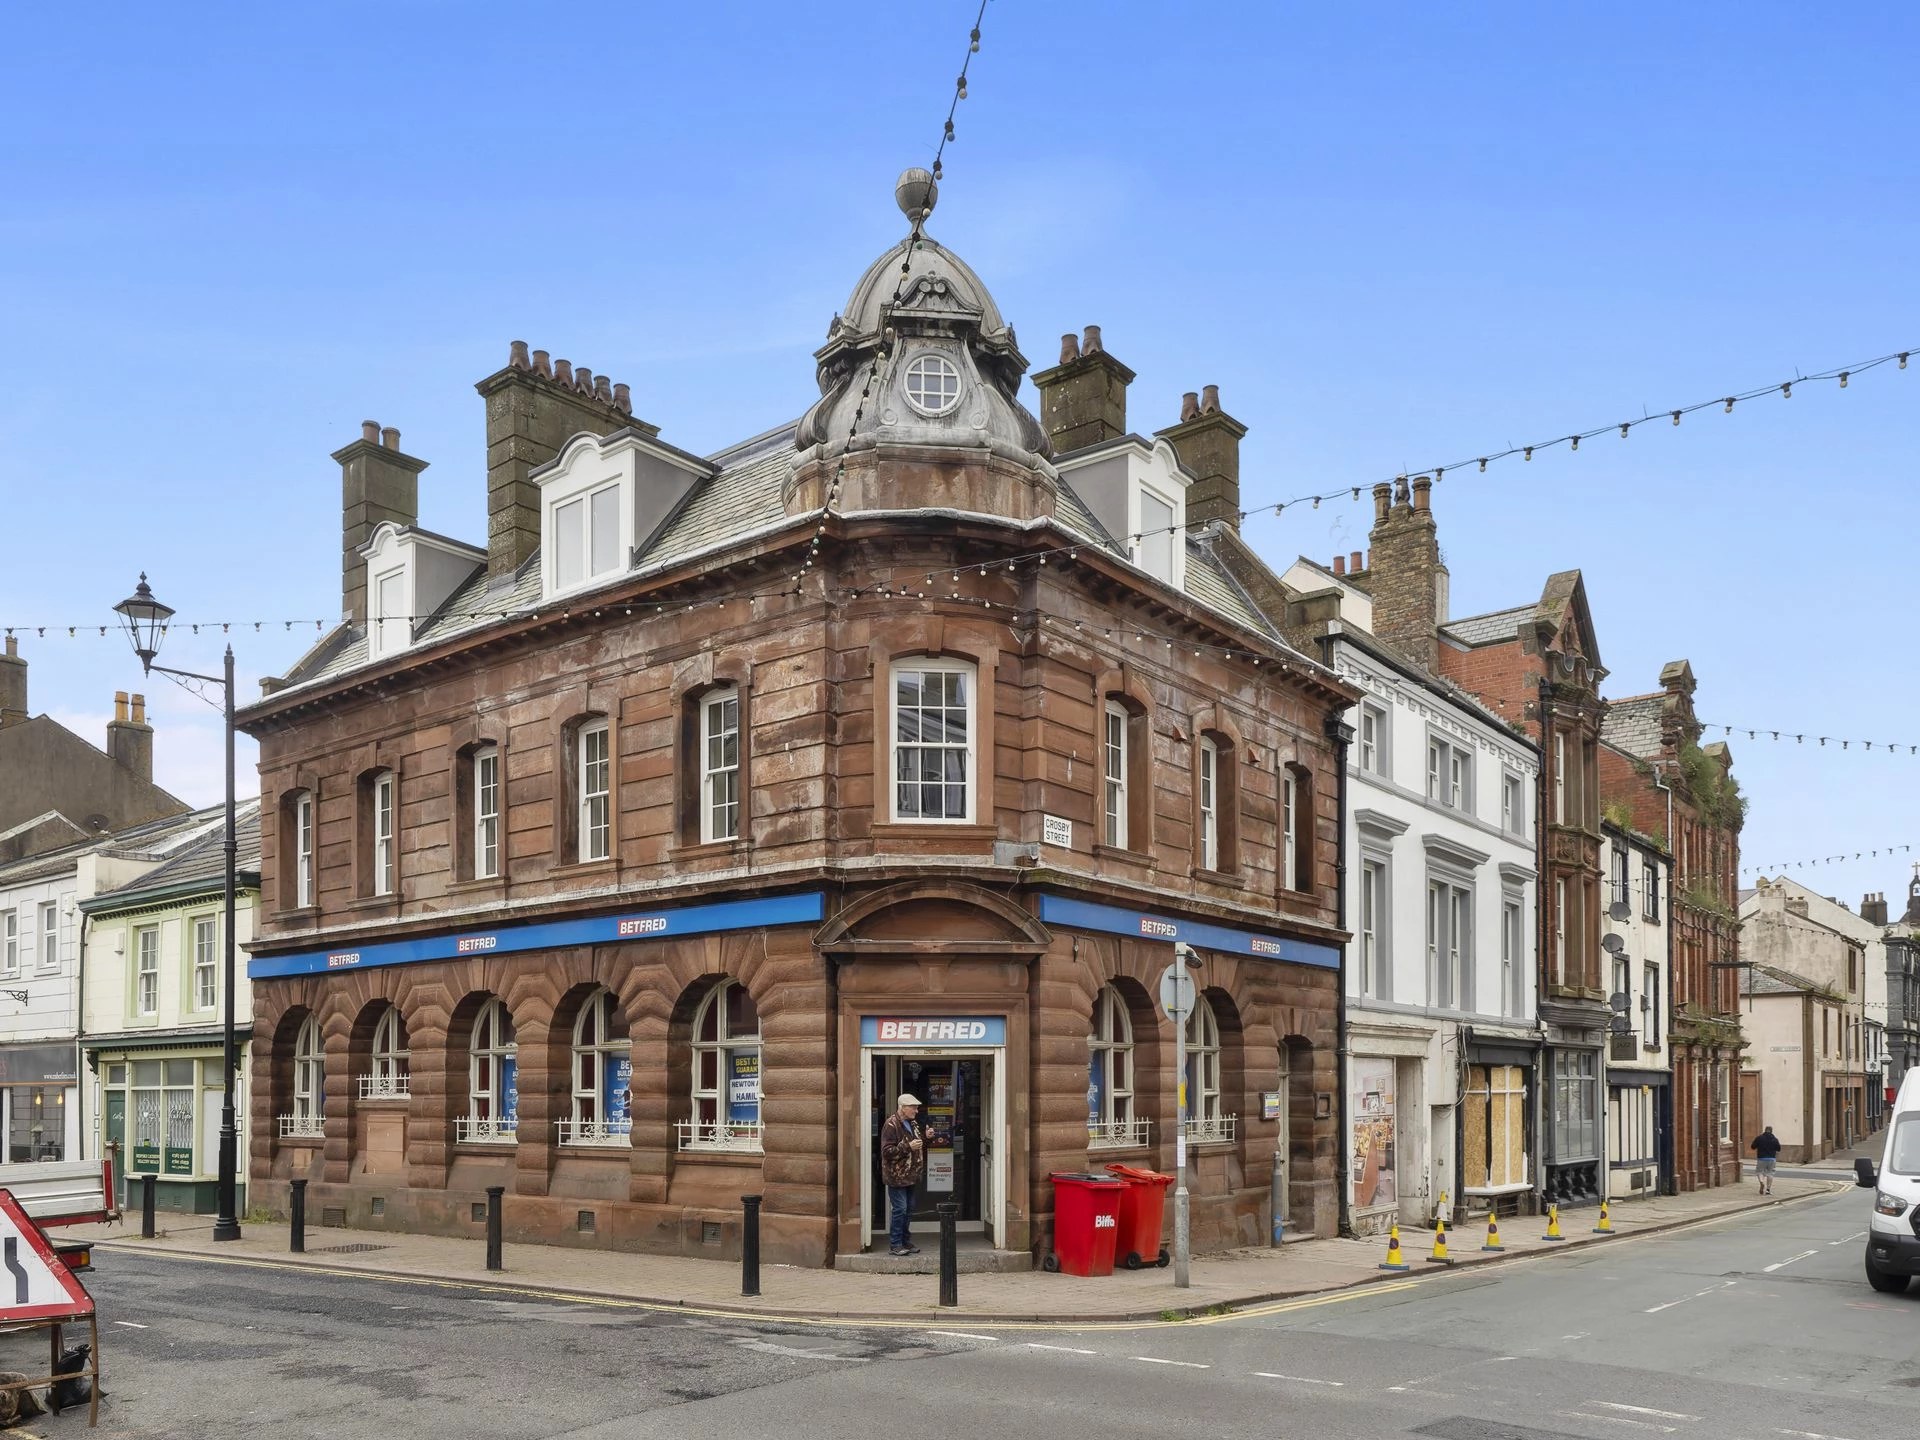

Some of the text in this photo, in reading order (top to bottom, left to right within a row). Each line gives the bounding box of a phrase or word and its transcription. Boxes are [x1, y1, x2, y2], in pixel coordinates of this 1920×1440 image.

[1046, 819, 1069, 832] CROSBY
[1046, 831, 1069, 843] STREET
[620, 918, 667, 934] BETFRED
[1141, 920, 1177, 936] BETFRED
[459, 937, 497, 951] BETFRED
[1252, 940, 1280, 953] BETFRED
[330, 953, 360, 966] BETFRED
[881, 1021, 986, 1039] BETFRED
[736, 1058, 750, 1066] BEST
[736, 1092, 758, 1101] HAMIL
[1095, 1215, 1115, 1228] Biffa
